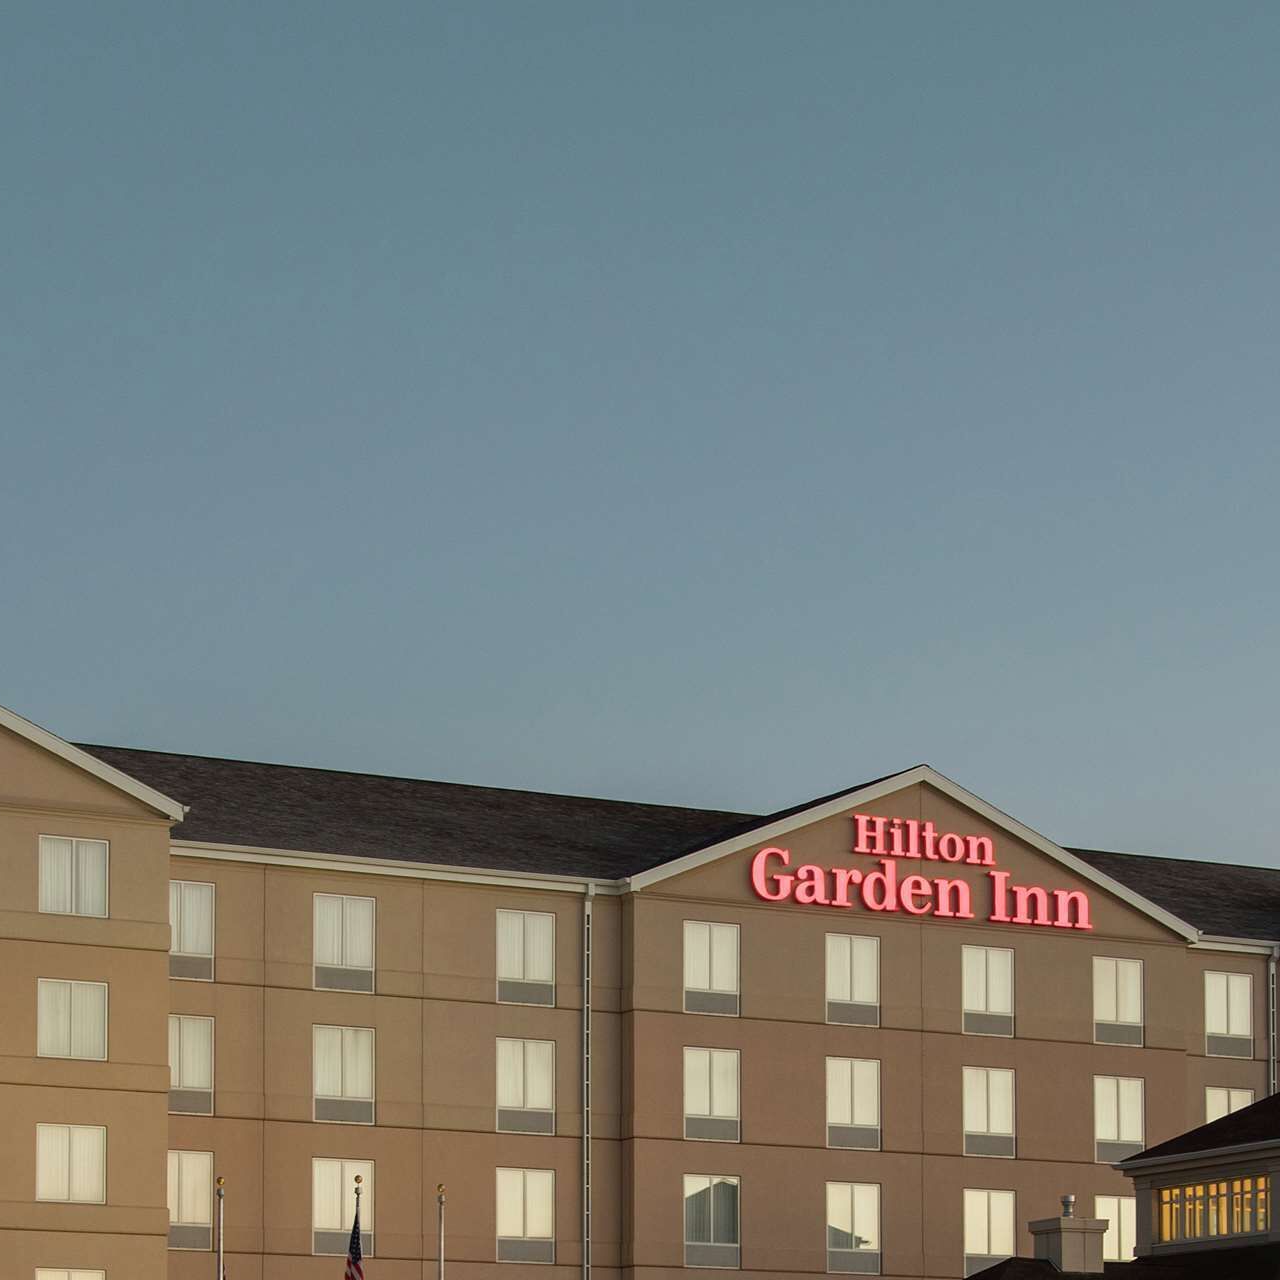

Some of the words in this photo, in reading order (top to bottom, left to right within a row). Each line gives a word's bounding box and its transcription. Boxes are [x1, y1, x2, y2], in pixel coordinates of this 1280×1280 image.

[853, 814, 996, 866] Hilton
[751, 846, 975, 919] Garden
[986, 870, 1093, 929] Inn
